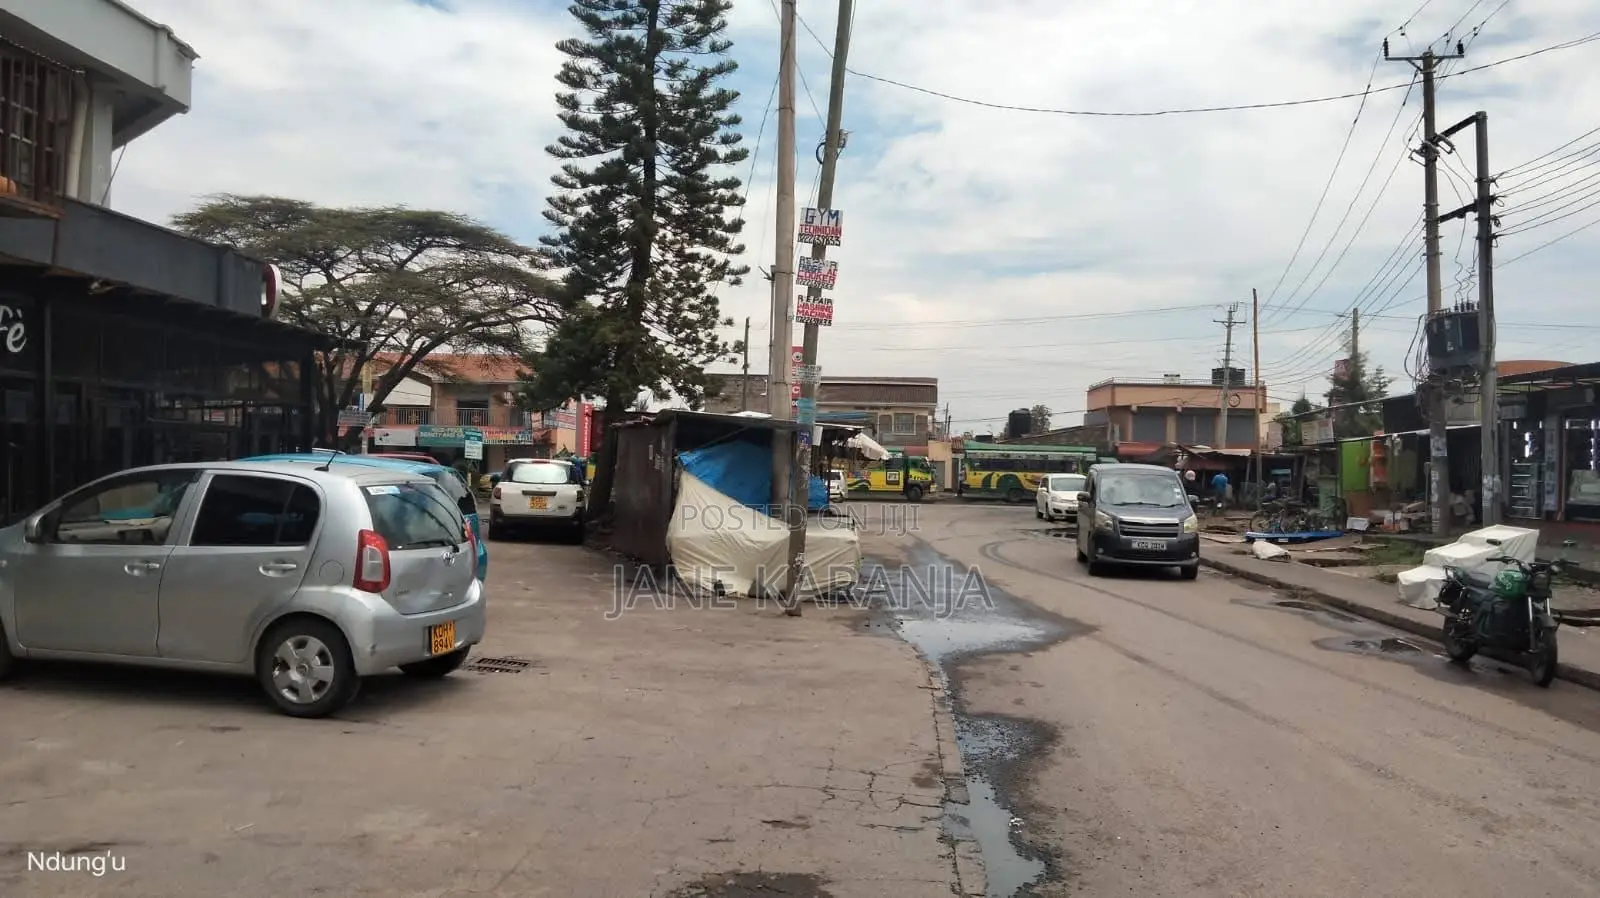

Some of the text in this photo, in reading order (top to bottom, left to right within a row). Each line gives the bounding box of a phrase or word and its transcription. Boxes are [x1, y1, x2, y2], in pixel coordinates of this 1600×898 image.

[805, 208, 840, 226] GYM
[797, 270, 835, 284] COOKER
[797, 294, 833, 306] REPAIR
[797, 303, 833, 313] WASHING
[796, 309, 833, 320] MACHINE
